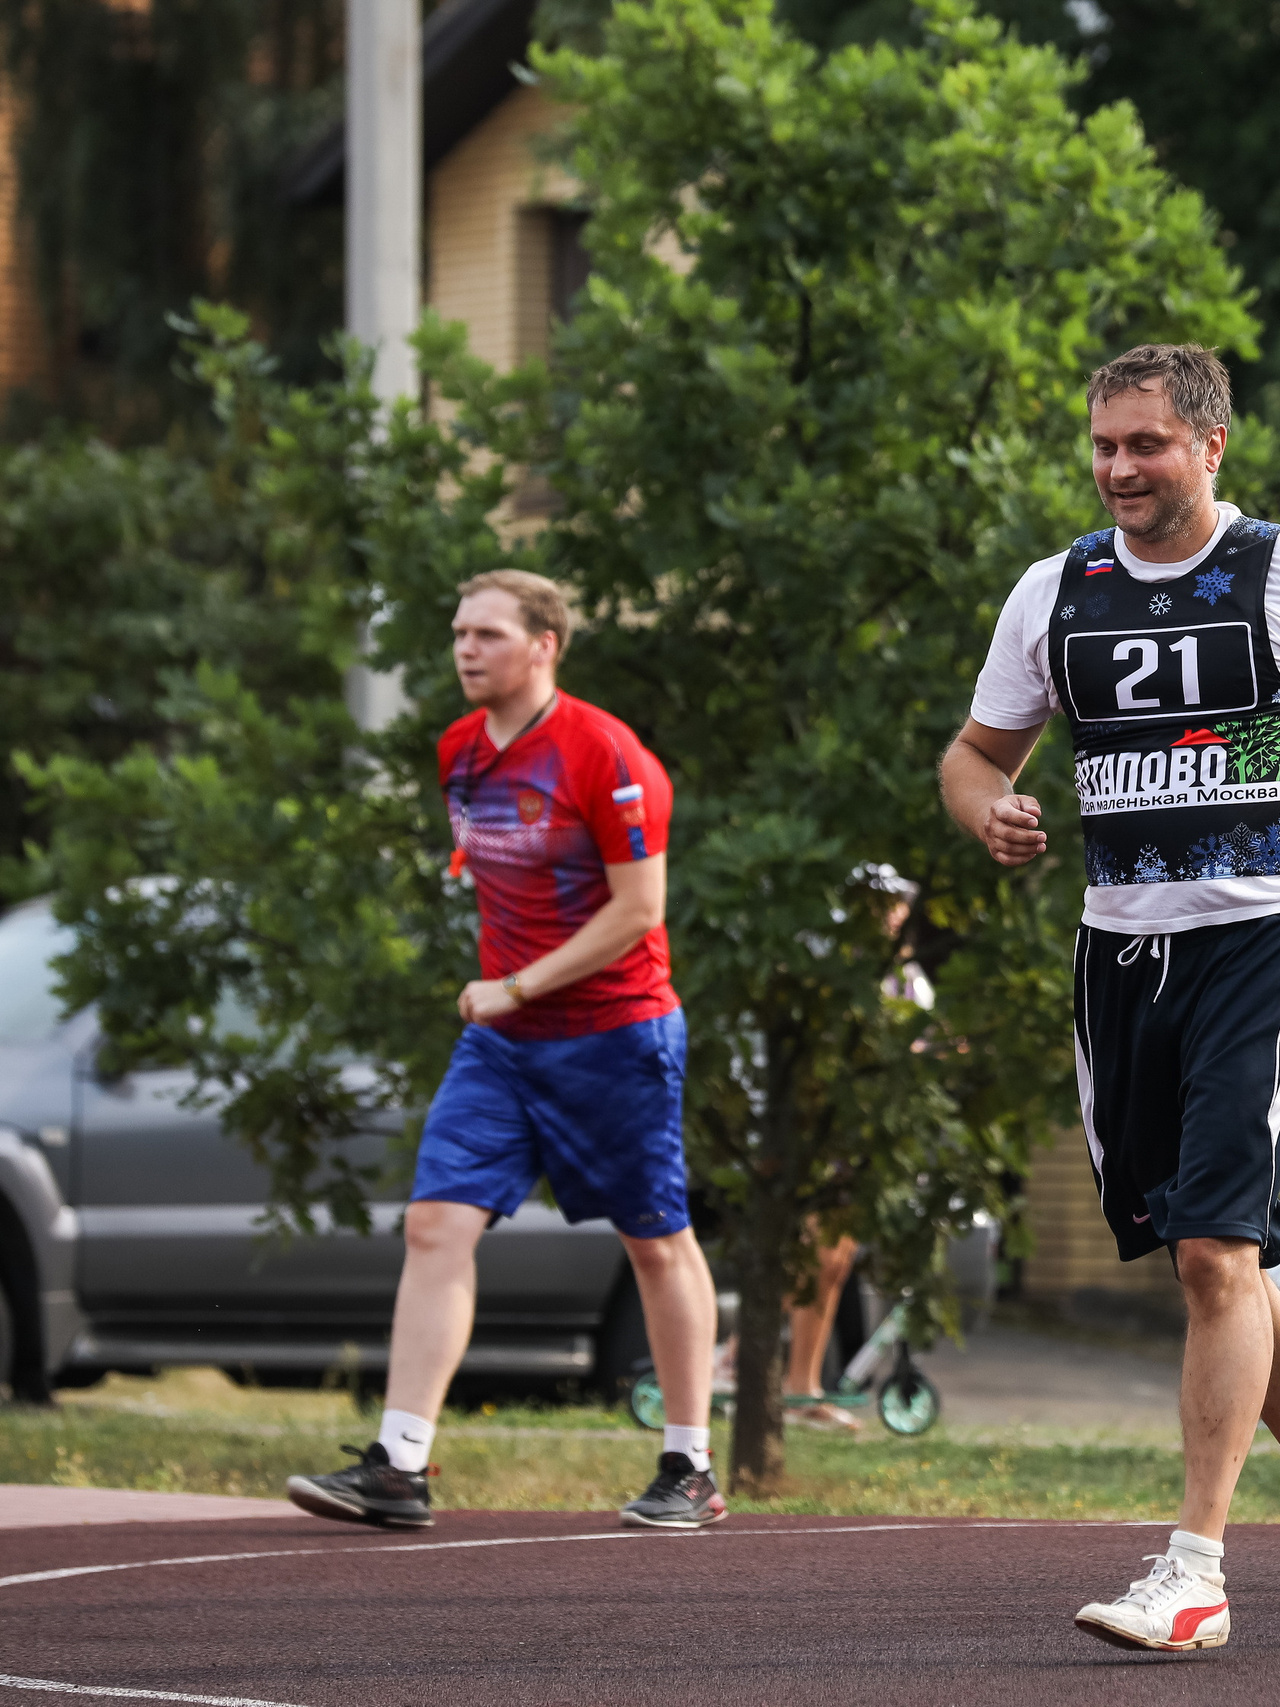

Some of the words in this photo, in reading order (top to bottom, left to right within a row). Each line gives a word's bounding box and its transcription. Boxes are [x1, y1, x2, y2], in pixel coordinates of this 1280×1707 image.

[1112, 635, 1201, 710] 21
[1097, 792, 1188, 811] маленькая
[1197, 787, 1279, 803] Москва
